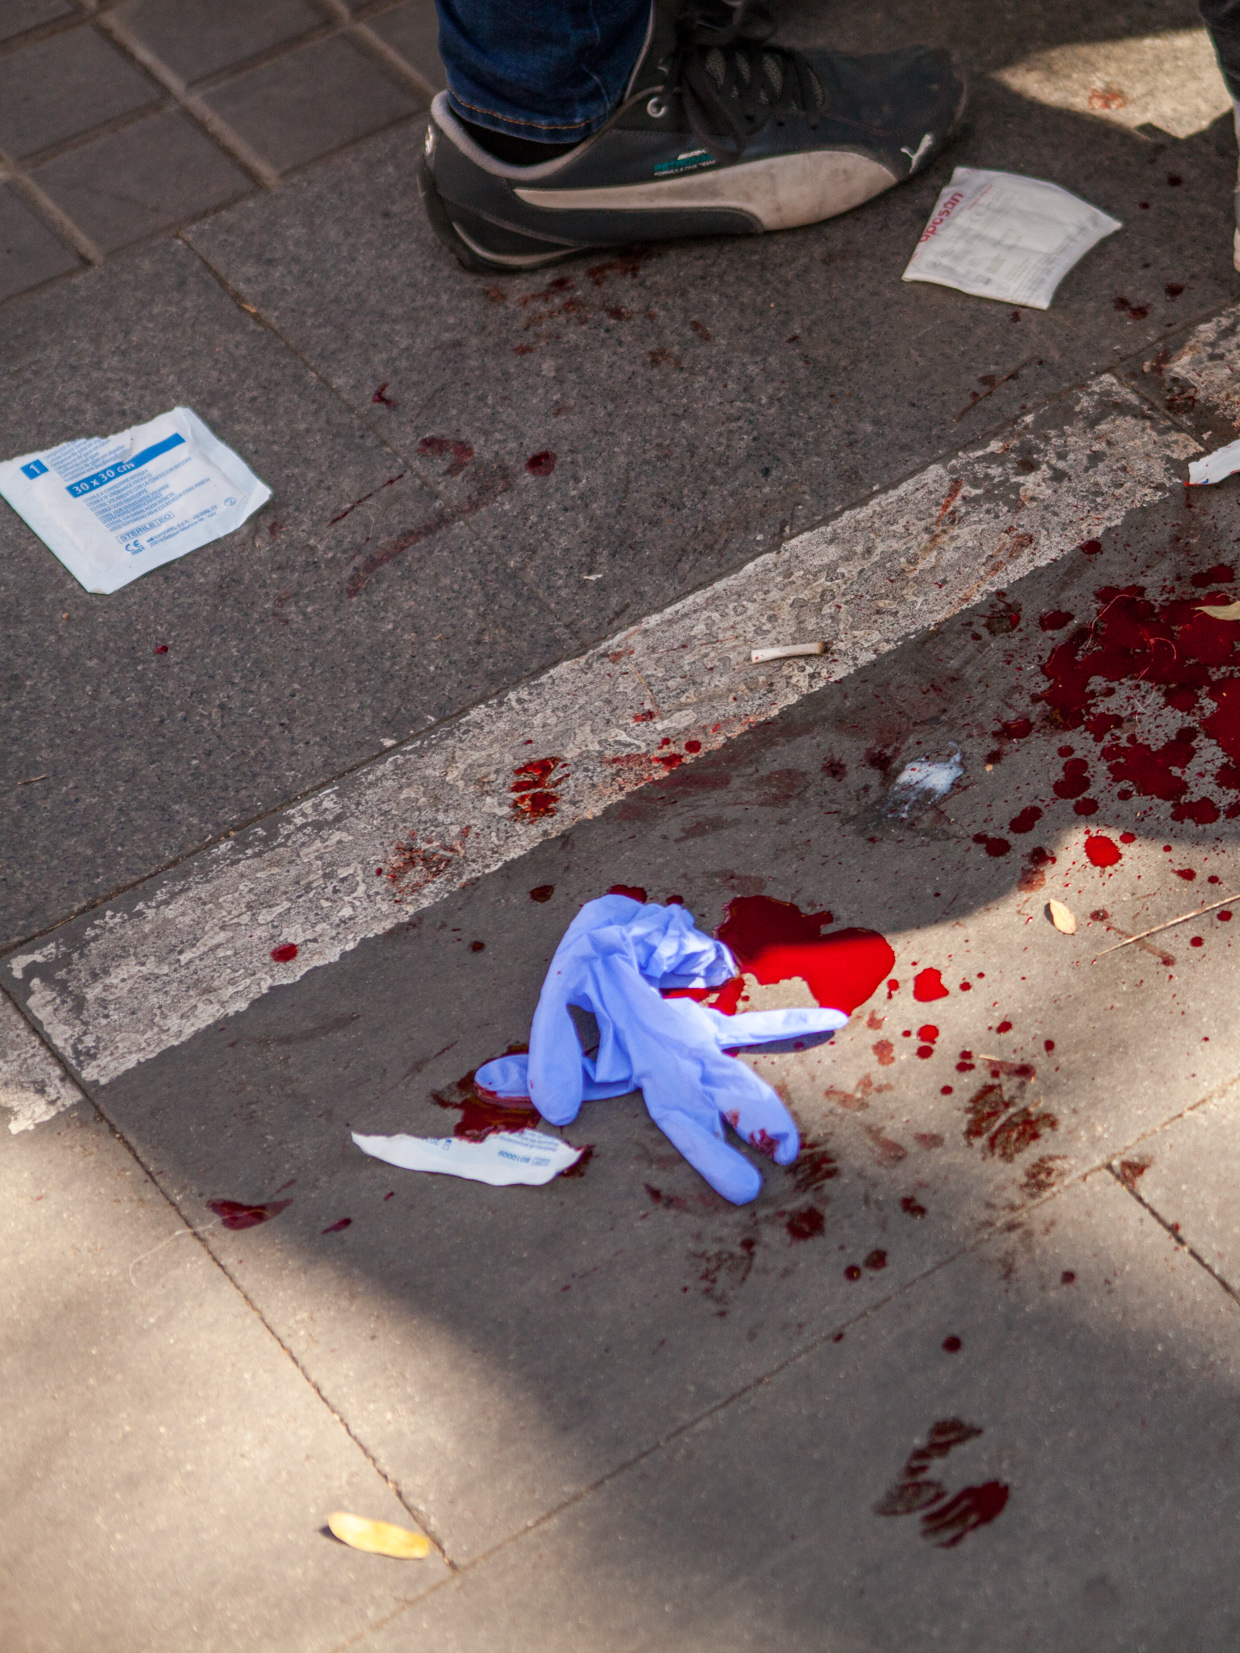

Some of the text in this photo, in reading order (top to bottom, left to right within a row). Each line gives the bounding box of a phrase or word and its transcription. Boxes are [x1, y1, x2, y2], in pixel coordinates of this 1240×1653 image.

[30, 463, 41, 475] 1
[72, 461, 135, 496] 30 x 30 cm
[106, 488, 134, 504] SOLAMENTE
[131, 483, 143, 491] CON
[172, 456, 192, 469] INTEGRA
[82, 493, 99, 503] STERILE
[102, 478, 130, 493] CONFEZIONE
[128, 468, 148, 480] INTEGRA
[85, 497, 103, 507] STERILE
[131, 472, 152, 485] PACKAGE
[94, 488, 149, 516] STERILE SOUS ENVELOPPE
[122, 494, 150, 510] VERWENDEN
[129, 501, 158, 518] EMBALAGEM
[156, 491, 175, 504] INTACTA
[118, 522, 155, 541] STERILE
[125, 539, 140, 552] CE
